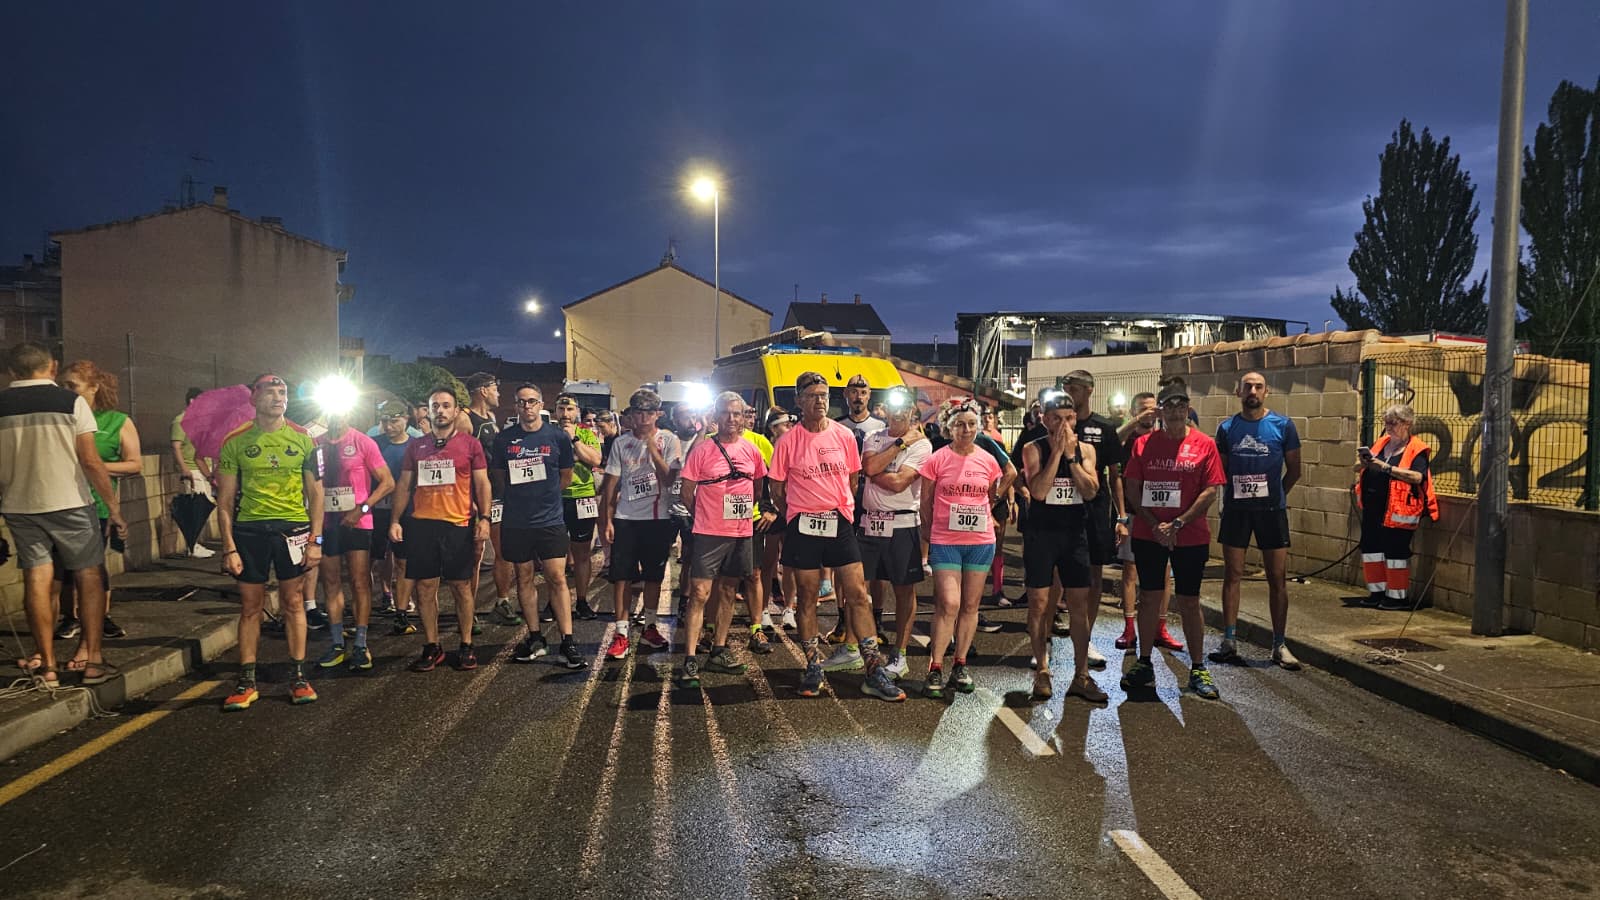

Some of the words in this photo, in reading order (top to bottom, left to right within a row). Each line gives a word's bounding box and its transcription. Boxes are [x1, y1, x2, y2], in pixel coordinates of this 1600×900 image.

[430, 469, 442, 480] 74
[520, 467, 534, 478] 75
[634, 482, 652, 494] 205
[1056, 487, 1074, 499] 312
[1240, 483, 1259, 494] 322
[1151, 490, 1170, 502] 307
[809, 518, 827, 531] 311
[870, 520, 885, 532] 314
[957, 514, 978, 526] 302
